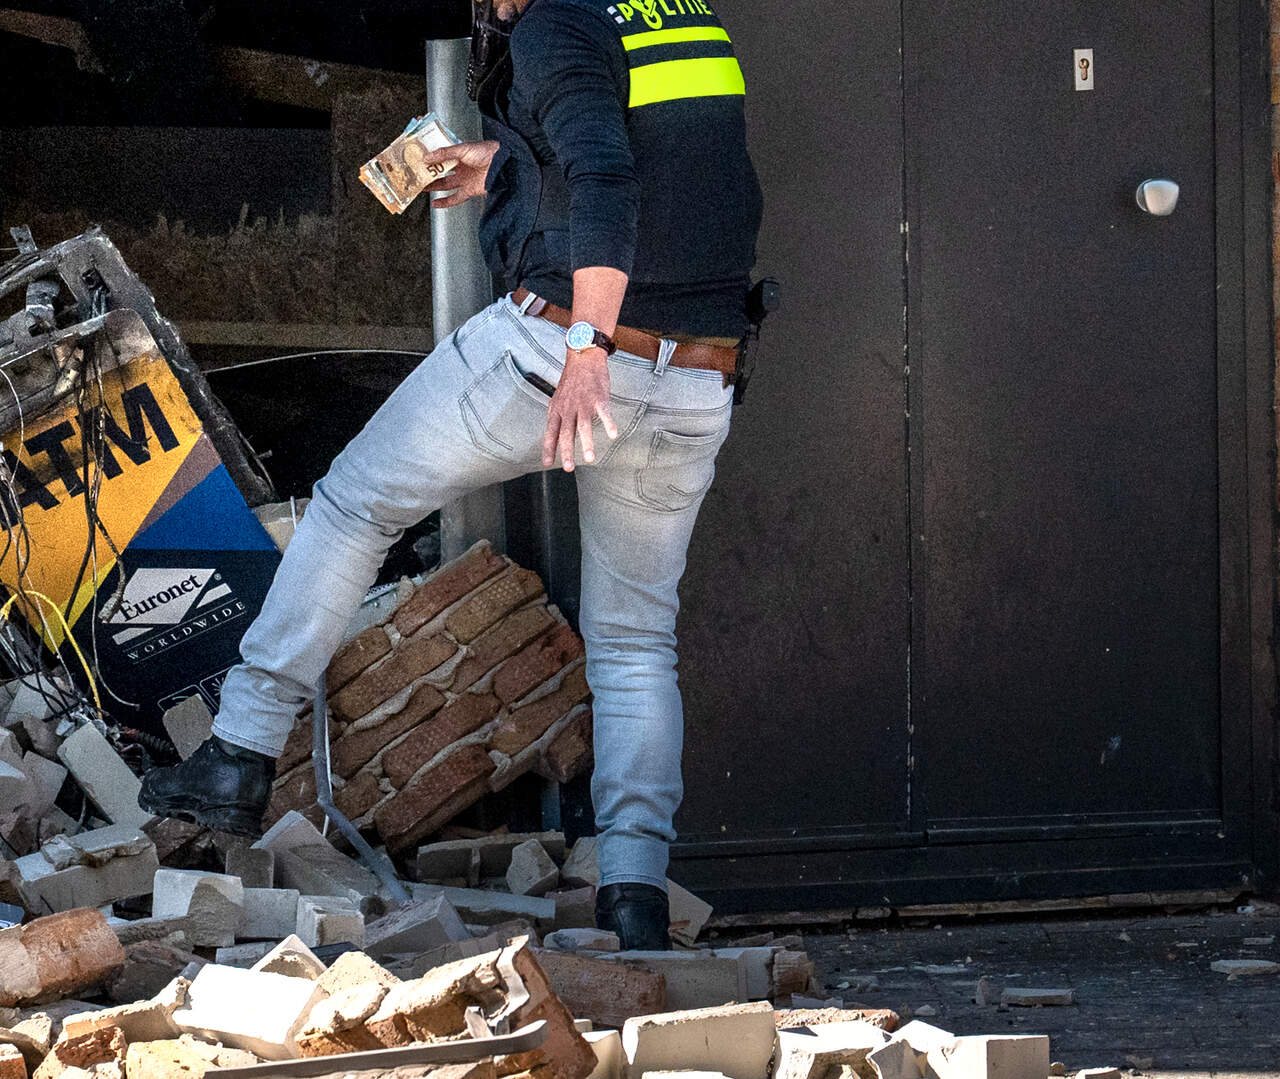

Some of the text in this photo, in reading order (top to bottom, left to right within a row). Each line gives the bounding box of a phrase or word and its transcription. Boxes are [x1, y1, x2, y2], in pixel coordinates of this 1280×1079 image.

[426, 163, 445, 178] 50
[119, 574, 202, 622] Euronet
[127, 601, 245, 660] WORLDWIDE
